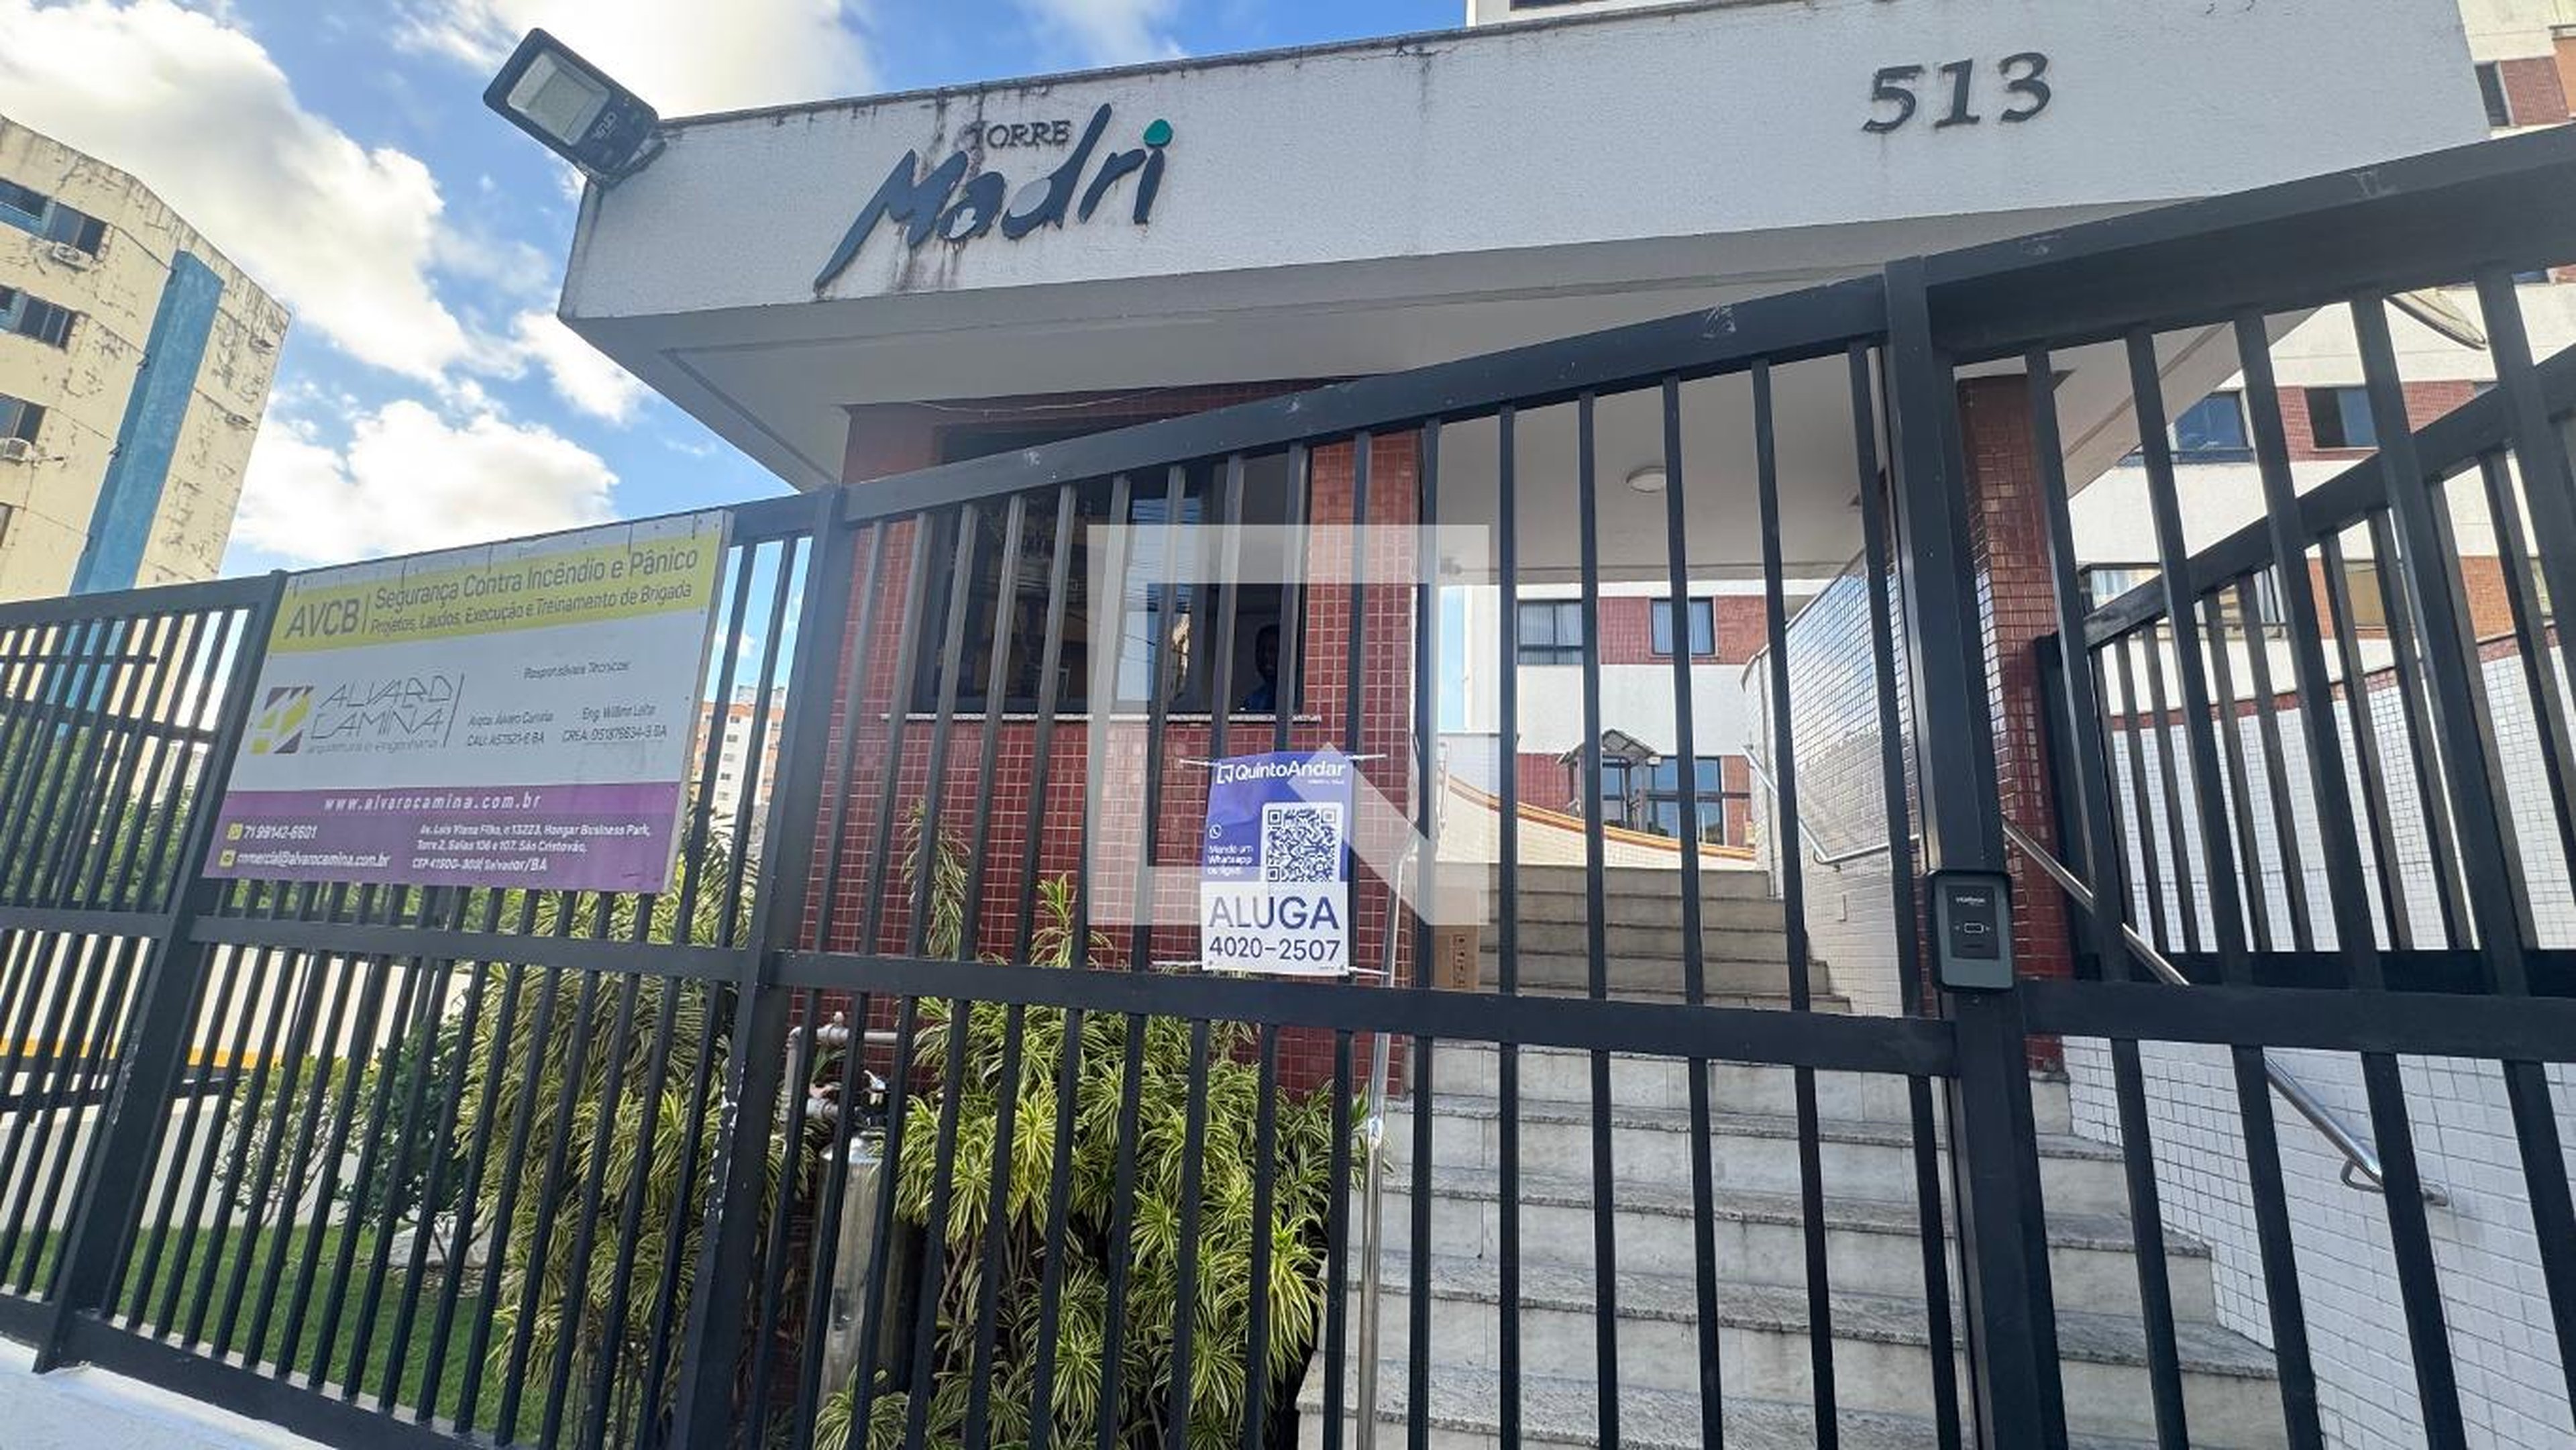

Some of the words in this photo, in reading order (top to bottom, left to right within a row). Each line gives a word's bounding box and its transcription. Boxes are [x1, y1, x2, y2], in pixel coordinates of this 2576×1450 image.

[1862, 52, 2051, 134] 513
[964, 120, 1071, 149] TORRE
[813, 103, 1173, 296] Madri
[374, 582, 459, 613] Segurança
[464, 572, 523, 598] Contra
[527, 558, 604, 590] Incêndio
[611, 560, 623, 578] e
[629, 546, 698, 576] Pânico
[285, 598, 360, 638] AVCB
[466, 603, 523, 624] Execução
[526, 603, 533, 617] e
[537, 593, 616, 616] Treinamento
[620, 588, 637, 605] de
[641, 580, 692, 605] Brigada
[1236, 760, 1346, 780] QuintoAndar
[324, 792, 541, 811] www.alvarocamina.com.br
[580, 825, 624, 835] Business
[1209, 896, 1340, 930] ALUGA
[1210, 936, 1340, 961] 4020-2507
